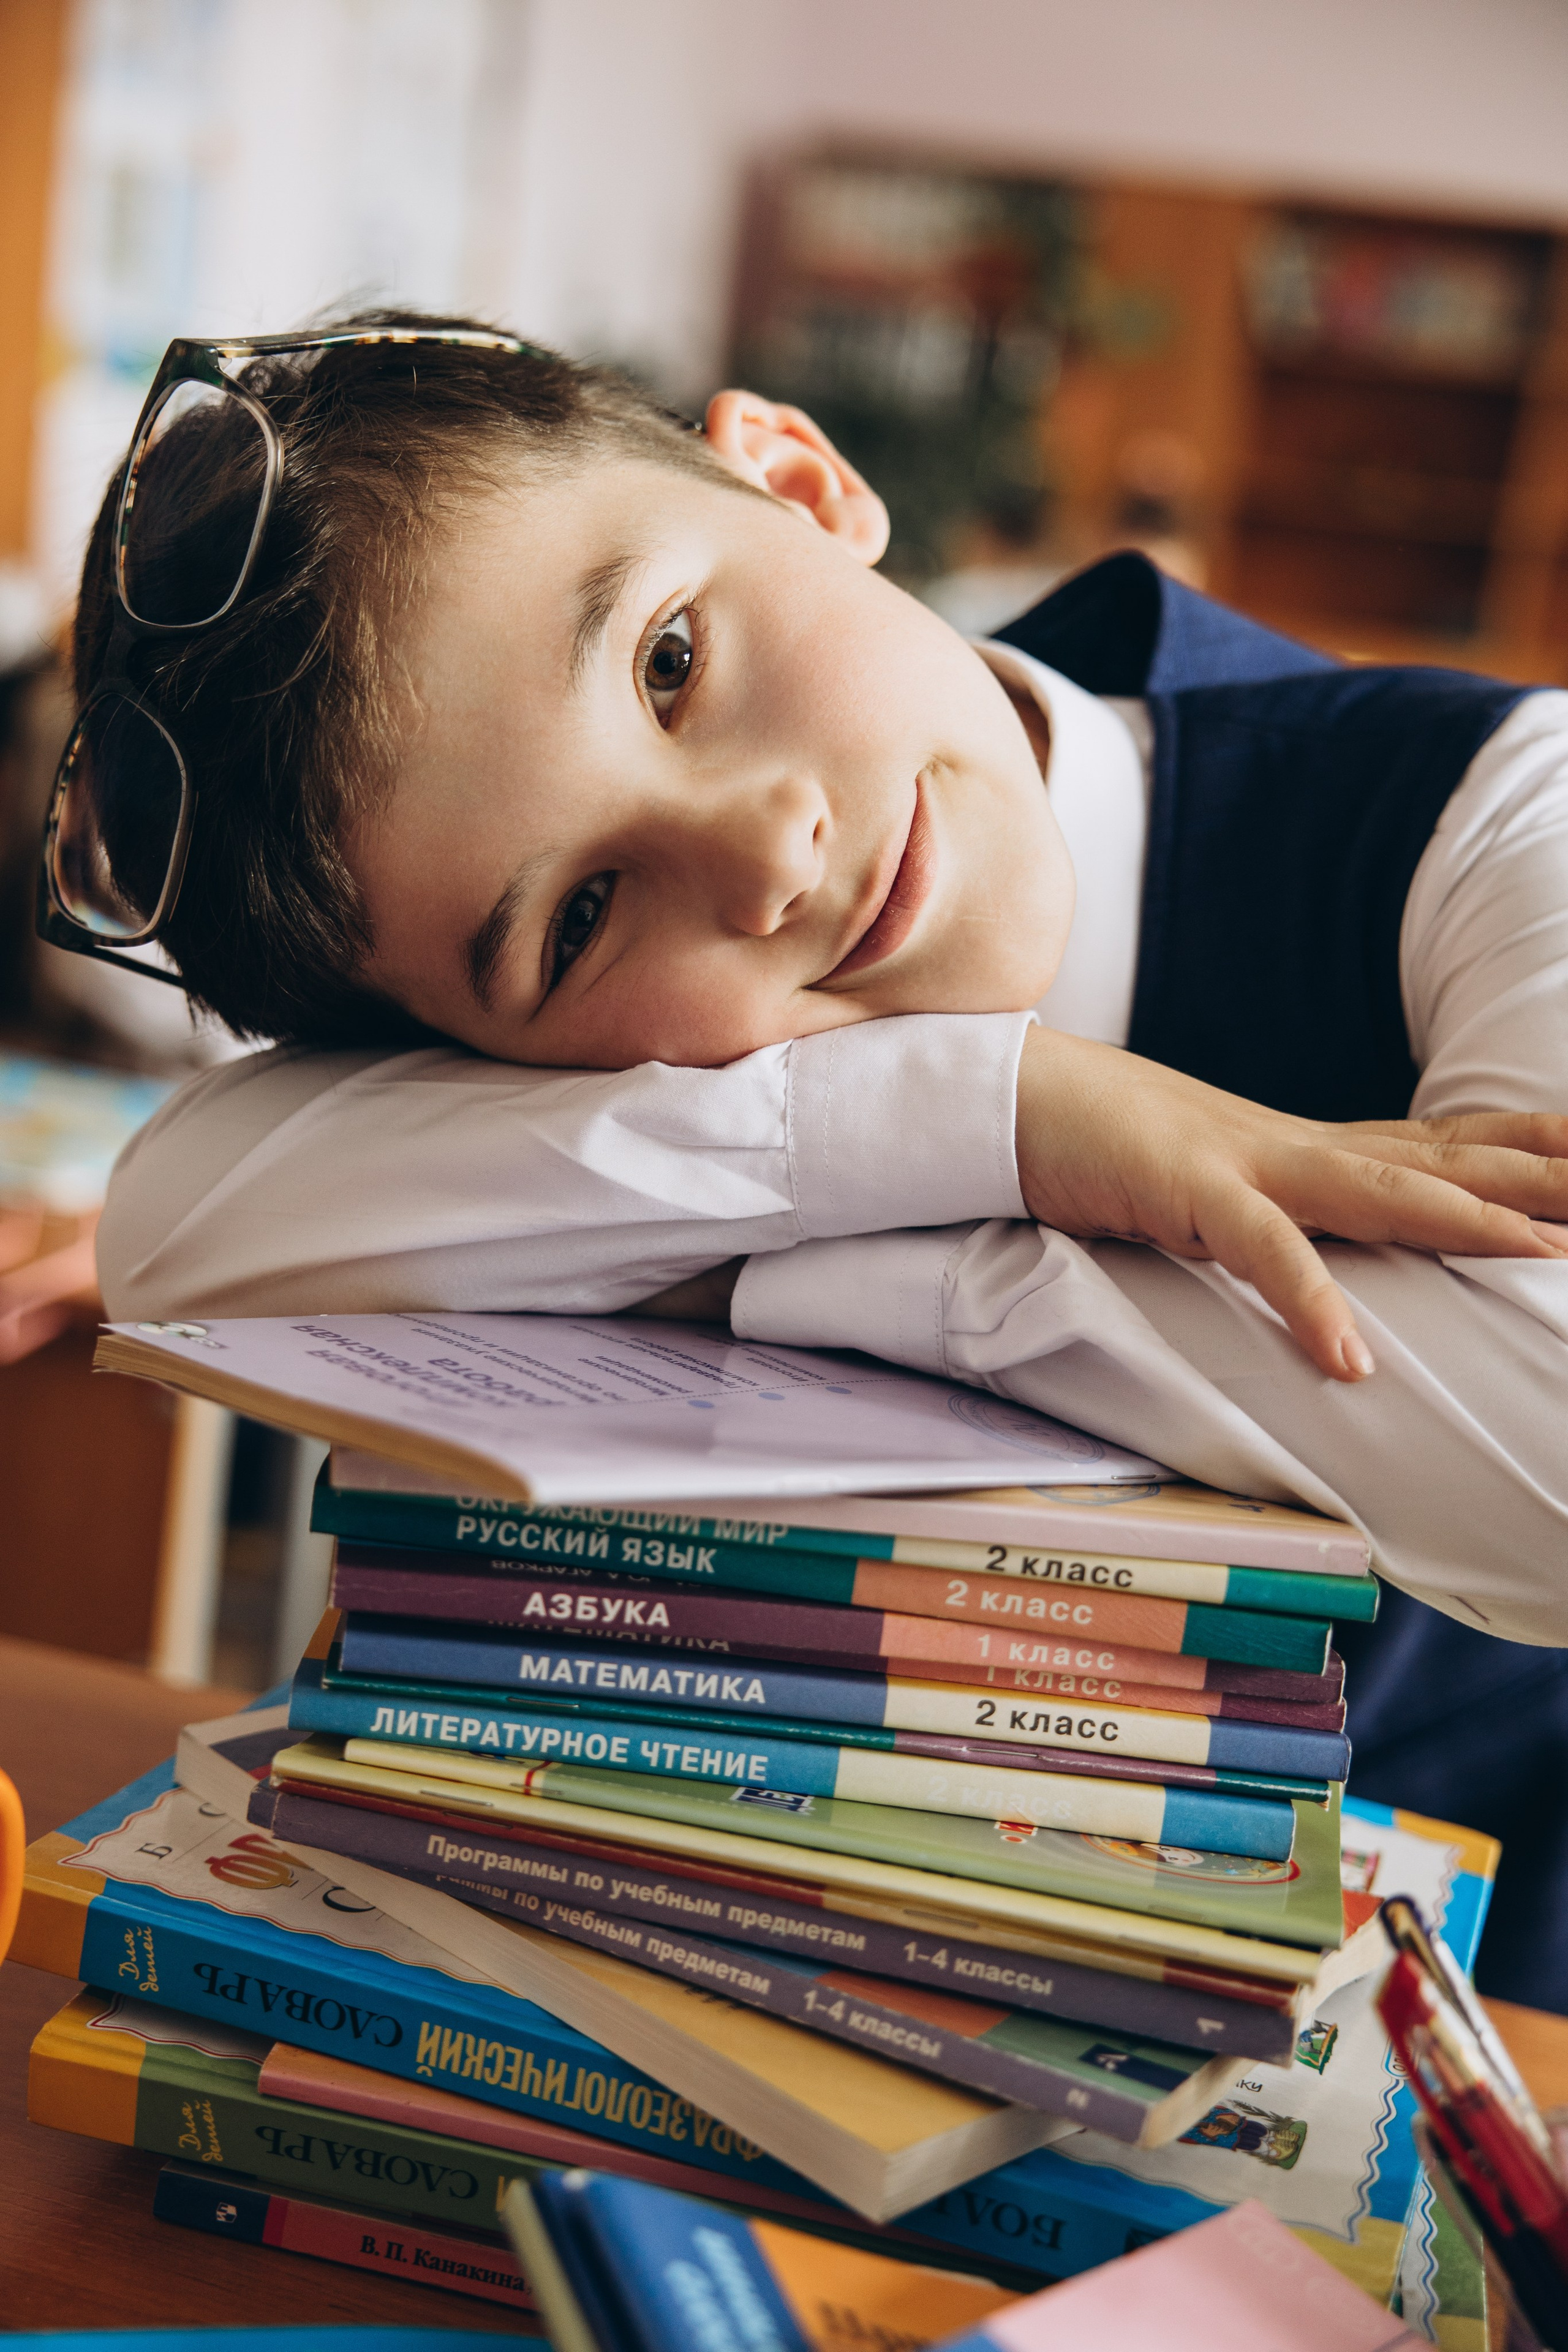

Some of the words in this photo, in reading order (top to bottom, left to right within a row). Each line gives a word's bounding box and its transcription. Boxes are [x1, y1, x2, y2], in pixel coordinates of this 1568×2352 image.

[411, 1328, 484, 1355] указания
[577, 1357, 672, 1397] Методические
[594, 1355, 694, 1395] рекомендации
[624, 1343, 742, 1389] Предварительная
[674, 1352, 761, 1387] комплексная
[745, 1357, 809, 1382] Итоговая
[455, 1515, 611, 1559] РУССКИЙ
[621, 1536, 718, 1574] ЯЗЫК
[985, 1544, 1008, 1572] 2
[1020, 1556, 1133, 1588] класс
[522, 1591, 671, 1628] АЗБУКА
[944, 1579, 968, 1607] 2
[979, 1591, 1094, 1625] класс
[978, 1634, 990, 1657] 1
[1008, 1642, 1115, 1670] класс
[519, 1654, 766, 1704] МАТЕМАТИКА
[1013, 1667, 1122, 1699] класс
[974, 1699, 997, 1727] 2
[1009, 1709, 1120, 1742] класс
[369, 1706, 631, 1764] ЛИТЕРАТУРНОЕ
[640, 1741, 769, 1782] ЧТЕНИЕ
[925, 1776, 949, 1802] 2
[960, 1787, 1072, 1820] класс
[426, 1834, 567, 1884] Программы
[573, 1871, 604, 1891] по
[611, 1879, 722, 1918] учебным
[727, 1905, 866, 1952] предметам
[952, 1952, 1055, 1996] классы
[118, 1926, 140, 1980] Для
[137, 1925, 160, 1993] детей
[514, 1889, 540, 1912] по
[543, 1899, 643, 1948] учебным
[646, 1936, 771, 1996] предметам
[846, 2010, 943, 2060] классы
[193, 1962, 404, 2048] СЛОВАРЬ
[178, 2101, 202, 2151] Для
[194, 2099, 224, 2162] детей
[255, 2125, 480, 2200] СЛОВАРЬ
[360, 2235, 380, 2256] В.
[383, 2241, 409, 2264] П.
